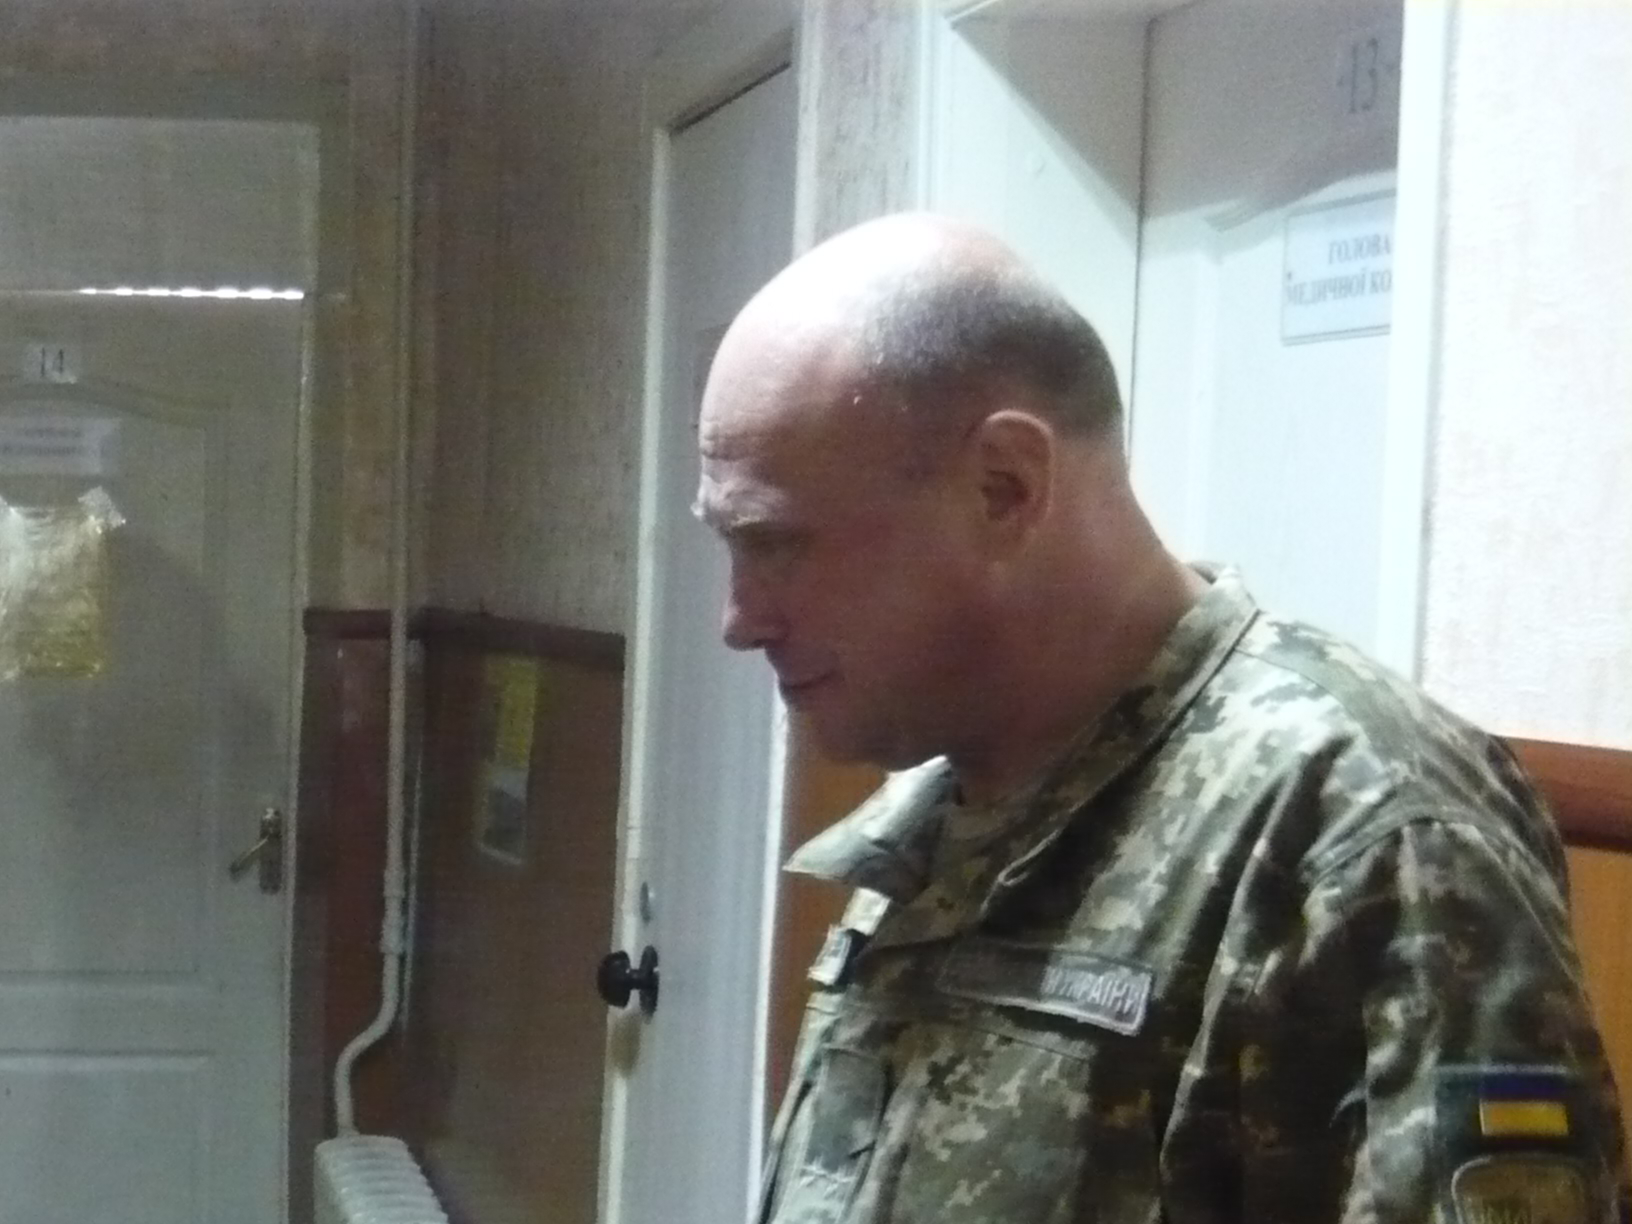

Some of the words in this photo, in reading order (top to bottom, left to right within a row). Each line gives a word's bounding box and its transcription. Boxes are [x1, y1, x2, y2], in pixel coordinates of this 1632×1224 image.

[1327, 232, 1391, 265] ГОЛОВА
[1285, 266, 1367, 305] МЕДИЧНОЇ
[39, 346, 66, 378] 14
